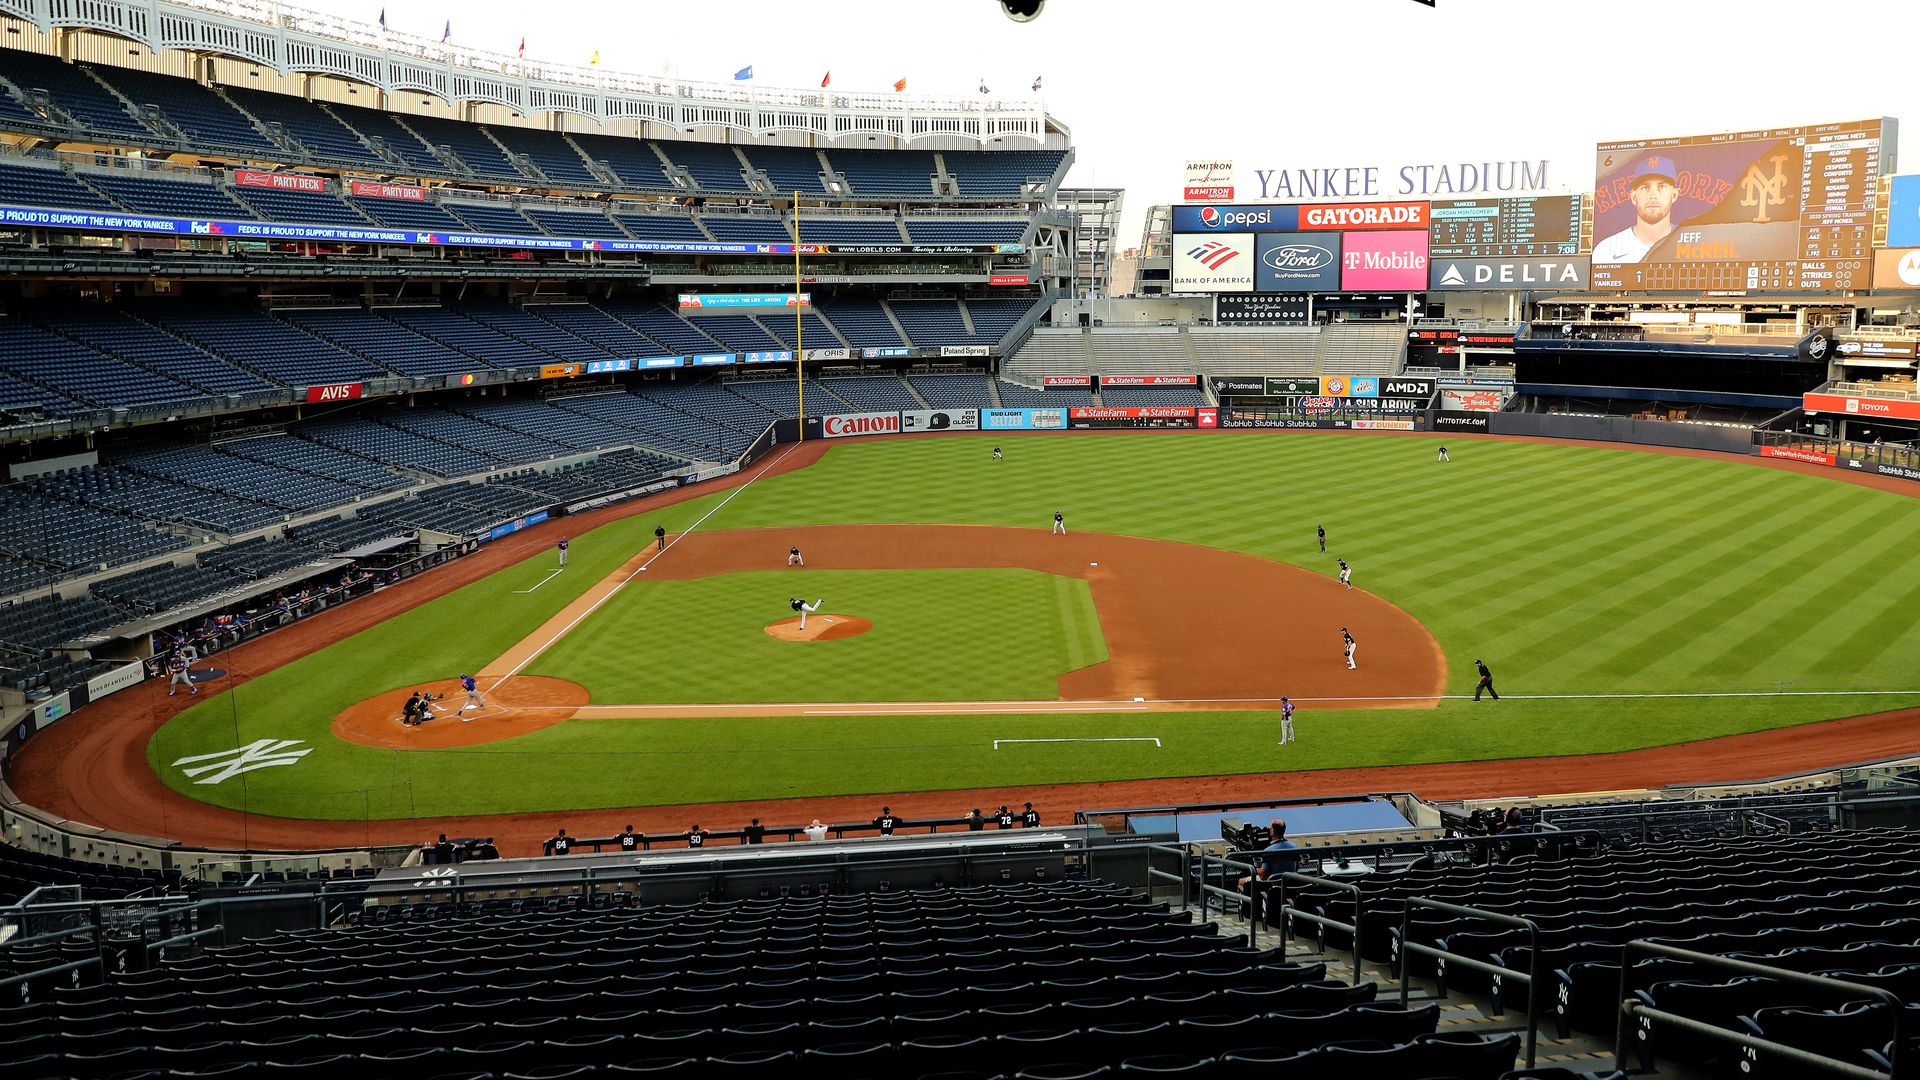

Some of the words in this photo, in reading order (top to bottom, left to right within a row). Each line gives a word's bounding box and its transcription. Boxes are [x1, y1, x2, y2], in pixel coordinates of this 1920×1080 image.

[1604, 155, 1612, 166] 6
[273, 176, 298, 187] PARTY
[300, 179, 319, 190] DECK
[1254, 167, 1379, 198] YANKEE
[1398, 160, 1550, 195] STADIUM
[382, 186, 402, 196] PARTY
[404, 188, 421, 198] DECK
[7, 211, 36, 222] PROUD
[36, 212, 49, 222] TO
[50, 215, 88, 225] SUPPORT
[89, 216, 104, 226] THE
[104, 217, 122, 227] NEW
[124, 218, 143, 228] YORK
[143, 220, 175, 230] YANKEES.
[1224, 210, 1272, 227] pepsi
[1308, 206, 1421, 225] GATORADE
[238, 226, 261, 234] FEDEX
[270, 227, 295, 236] PROUD
[306, 229, 335, 237] SUPPORT
[380, 232, 406, 241] YANKEES.
[1678, 232, 1701, 243] JEFF
[1275, 248, 1320, 268] Ford
[1364, 251, 1425, 270] Mobile
[1475, 263, 1579, 283] DELTA
[965, 347, 986, 355] Spring
[321, 385, 349, 400] AVIS
[1386, 383, 1417, 393] AMD
[1150, 408, 1169, 417] State
[1860, 403, 1889, 412] TOYOTA
[1088, 409, 1107, 418] State
[824, 415, 898, 435] Canon
[991, 416, 1022, 426] SELTZER
[1437, 417, 1486, 425] NITTOTIRE.COM
[1878, 466, 1903, 475] StubHub
[90, 686, 103, 694] BANK
[111, 674, 133, 686] AMERICA
[882, 819, 892, 828] 27
[1001, 816, 1012, 824] 72
[1027, 814, 1036, 822] 71
[556, 841, 566, 849] 64
[690, 836, 700, 844] 50
